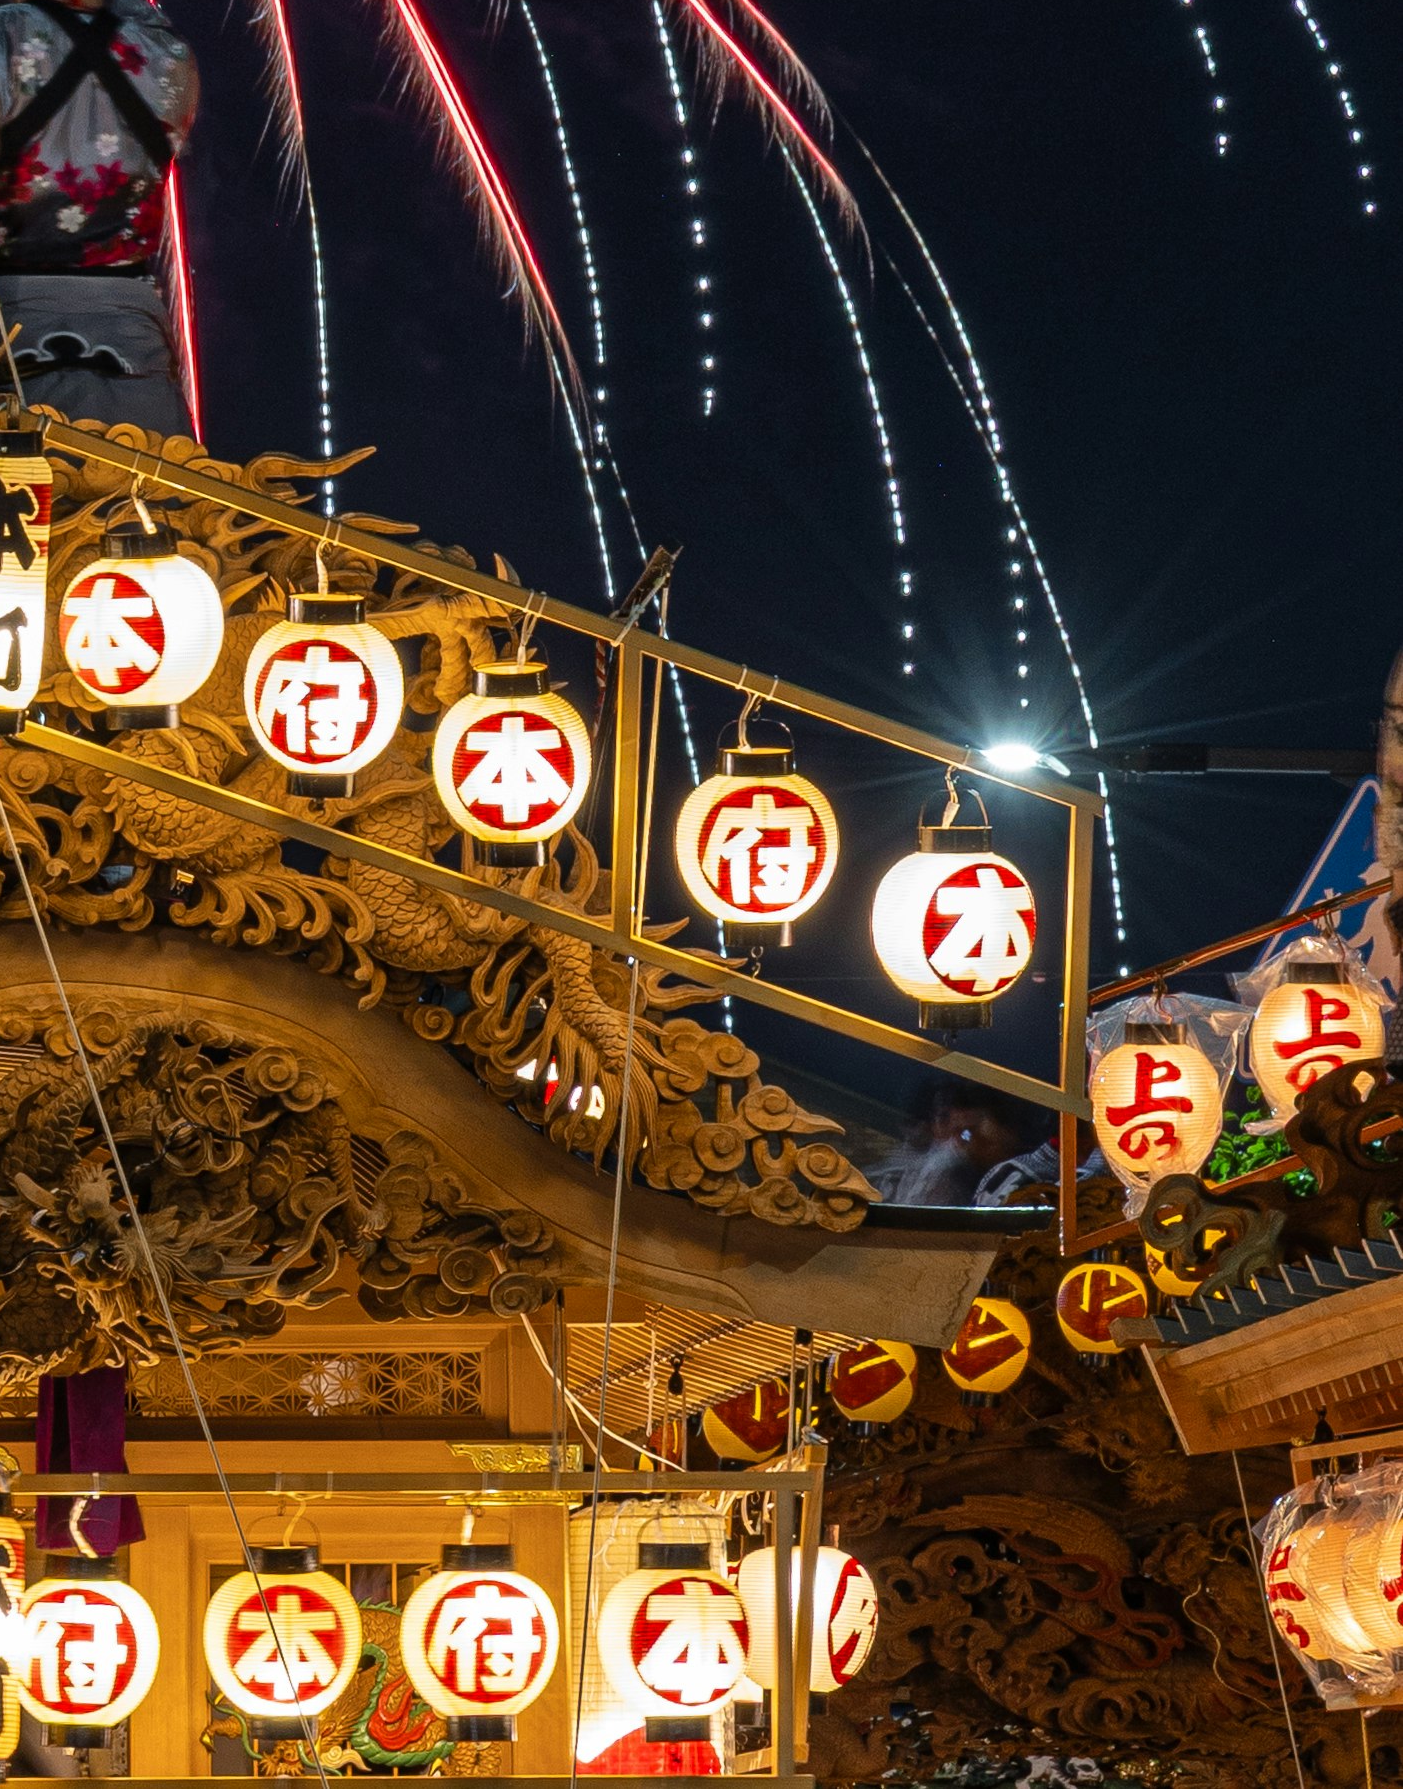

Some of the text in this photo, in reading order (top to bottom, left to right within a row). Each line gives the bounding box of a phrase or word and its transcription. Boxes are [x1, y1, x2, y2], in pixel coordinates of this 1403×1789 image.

[64, 580, 160, 687] 本
[458, 717, 572, 822] 本
[928, 868, 1033, 991] 本
[1105, 1052, 1193, 1161] 上の
[235, 1595, 338, 1700] 本
[638, 1581, 748, 1703] 本
